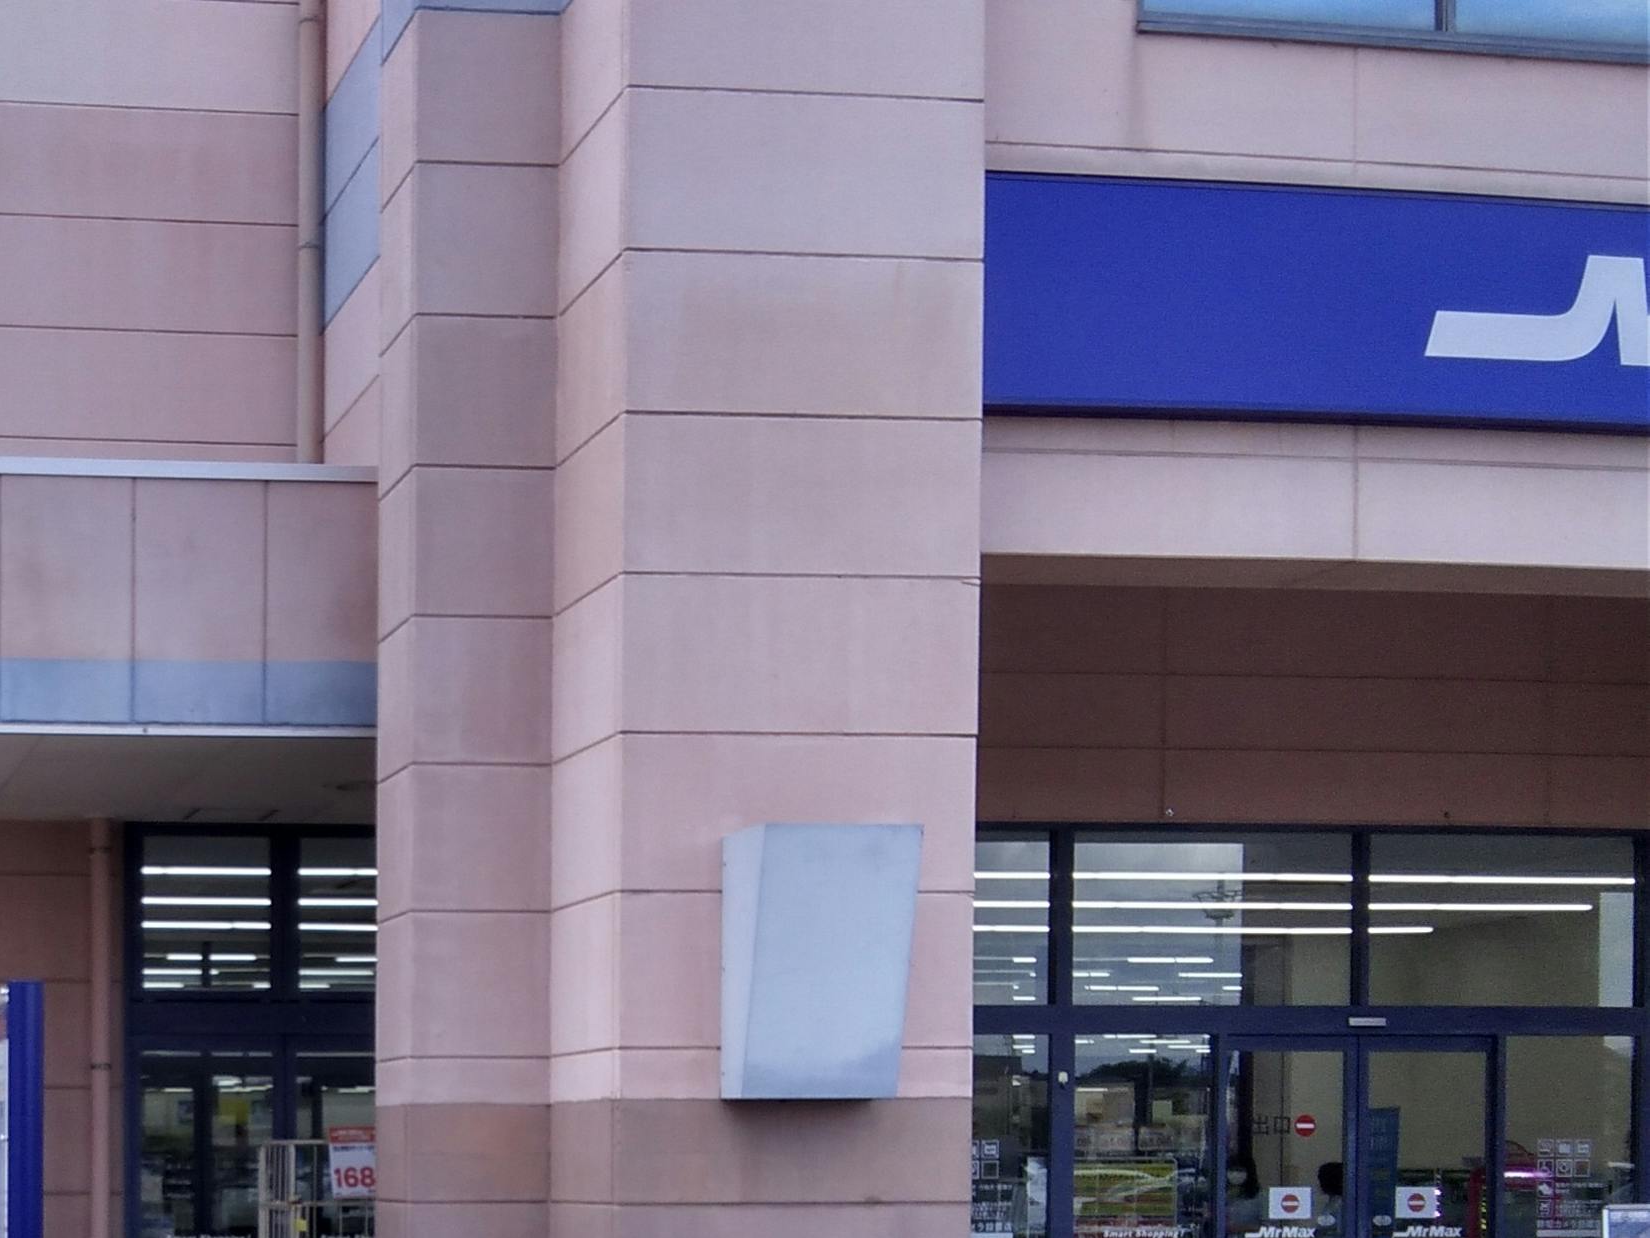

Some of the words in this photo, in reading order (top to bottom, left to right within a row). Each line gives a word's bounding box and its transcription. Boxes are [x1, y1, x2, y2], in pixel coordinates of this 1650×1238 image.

[334, 1166, 376, 1188] 168
[1103, 1229, 1133, 1238] Smart
[1244, 1226, 1316, 1238] MrMax
[1392, 1226, 1463, 1238] MrMax
